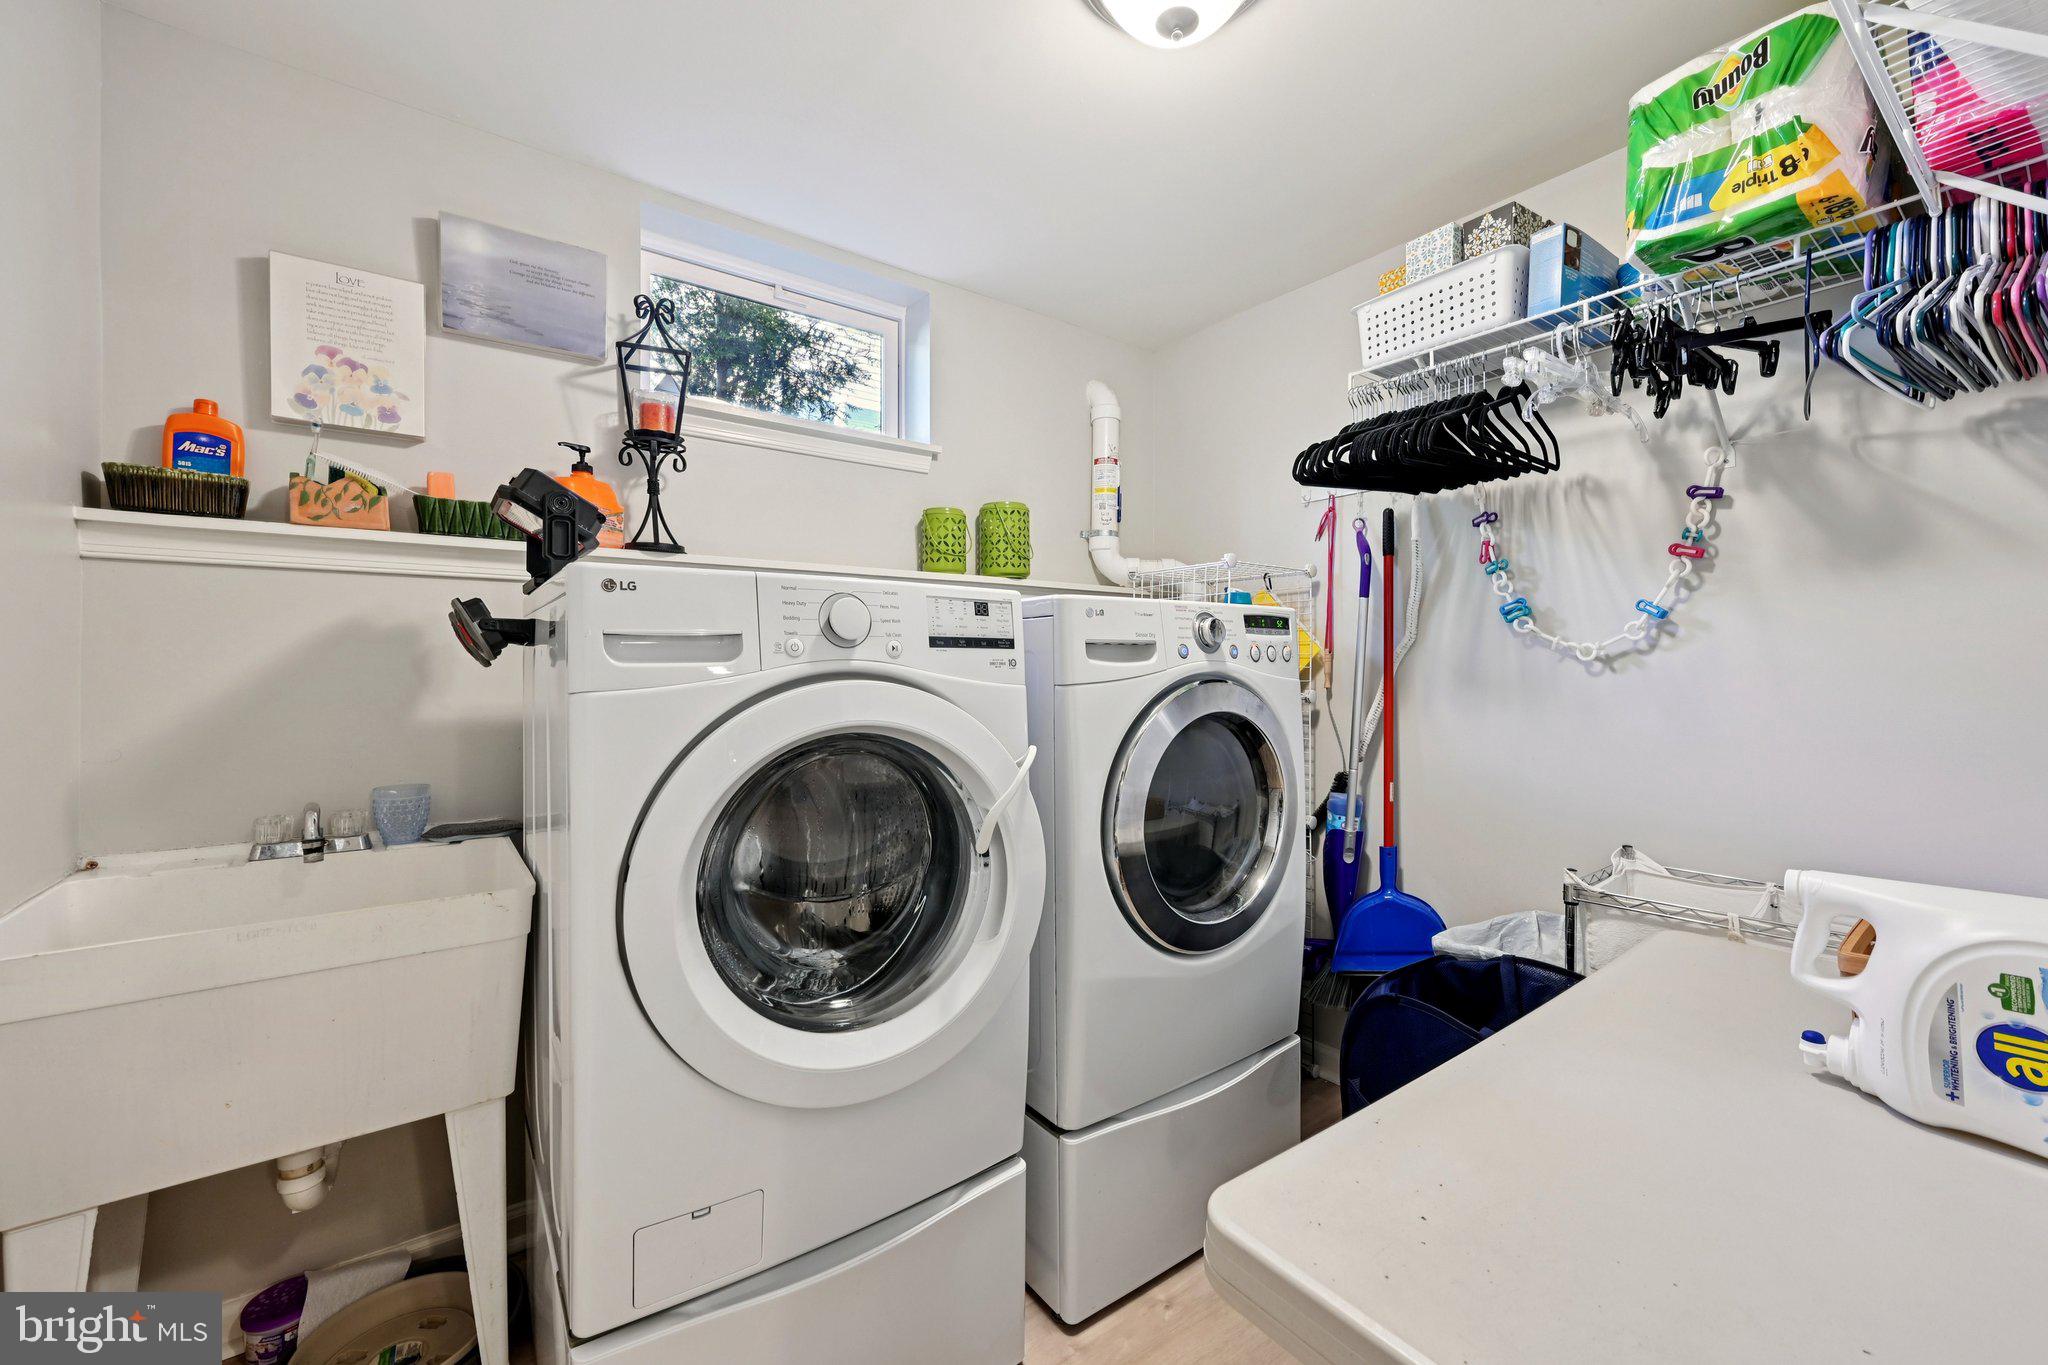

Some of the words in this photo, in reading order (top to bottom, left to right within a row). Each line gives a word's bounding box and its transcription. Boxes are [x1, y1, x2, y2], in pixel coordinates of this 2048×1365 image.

[1692, 36, 1769, 110] Bounty
[1731, 170, 1779, 193] Triple
[177, 441, 227, 457] Mac's
[1946, 998, 1958, 1045] BRIGHTENING
[1942, 1059, 1951, 1089] SUPERIOR
[1949, 1050, 1959, 1092] WHITENING
[1993, 1031, 2048, 1087] all
